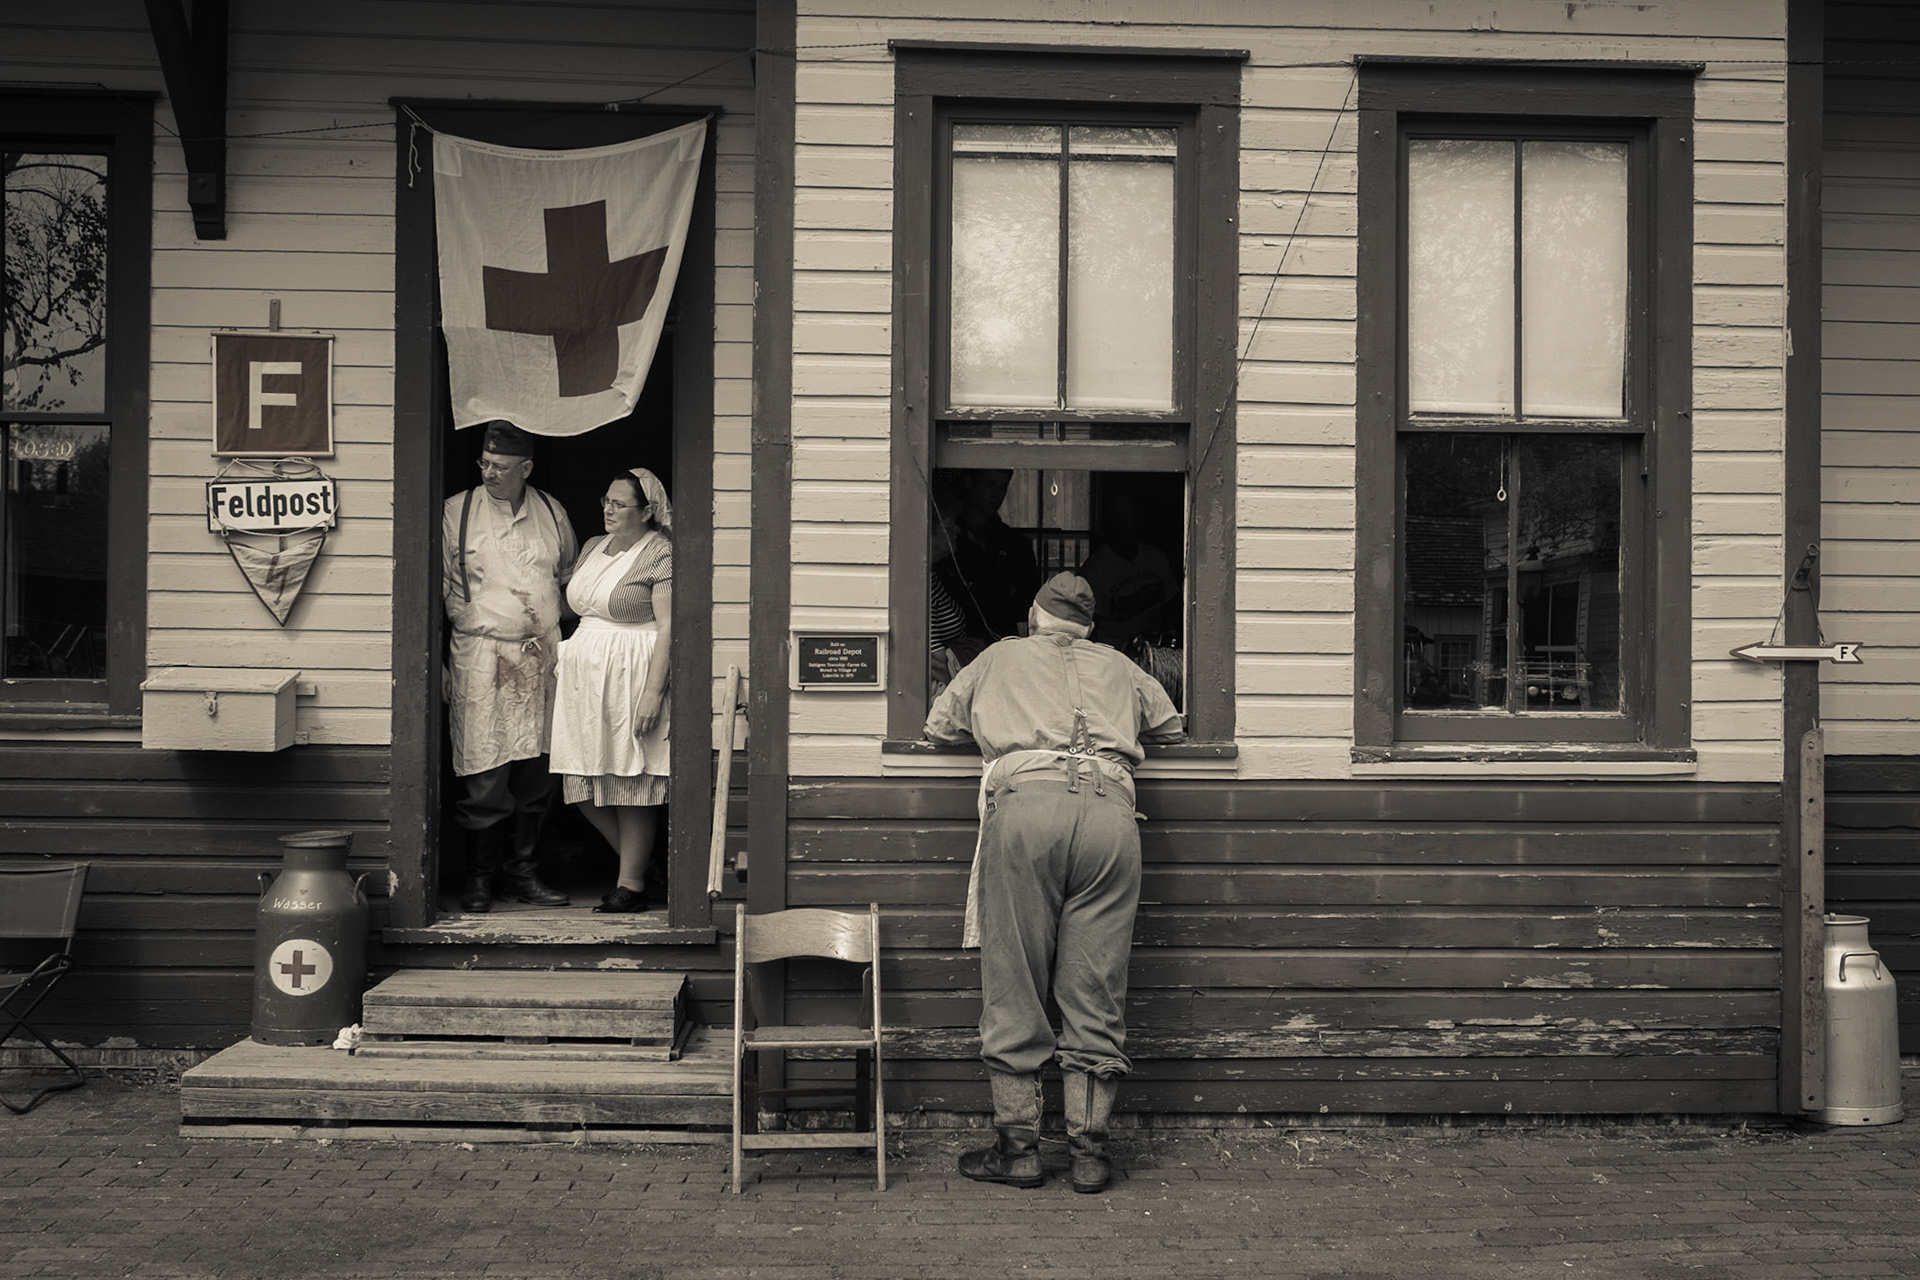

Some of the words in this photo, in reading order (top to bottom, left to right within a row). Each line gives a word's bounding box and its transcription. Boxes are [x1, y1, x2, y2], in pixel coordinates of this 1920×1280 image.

[249, 361, 302, 429] F
[14, 439, 73, 458] LOSED
[211, 485, 332, 525] Feldpost
[843, 648, 862, 656] Depot
[1841, 646, 1848, 659] F
[273, 898, 323, 910] Wasser
